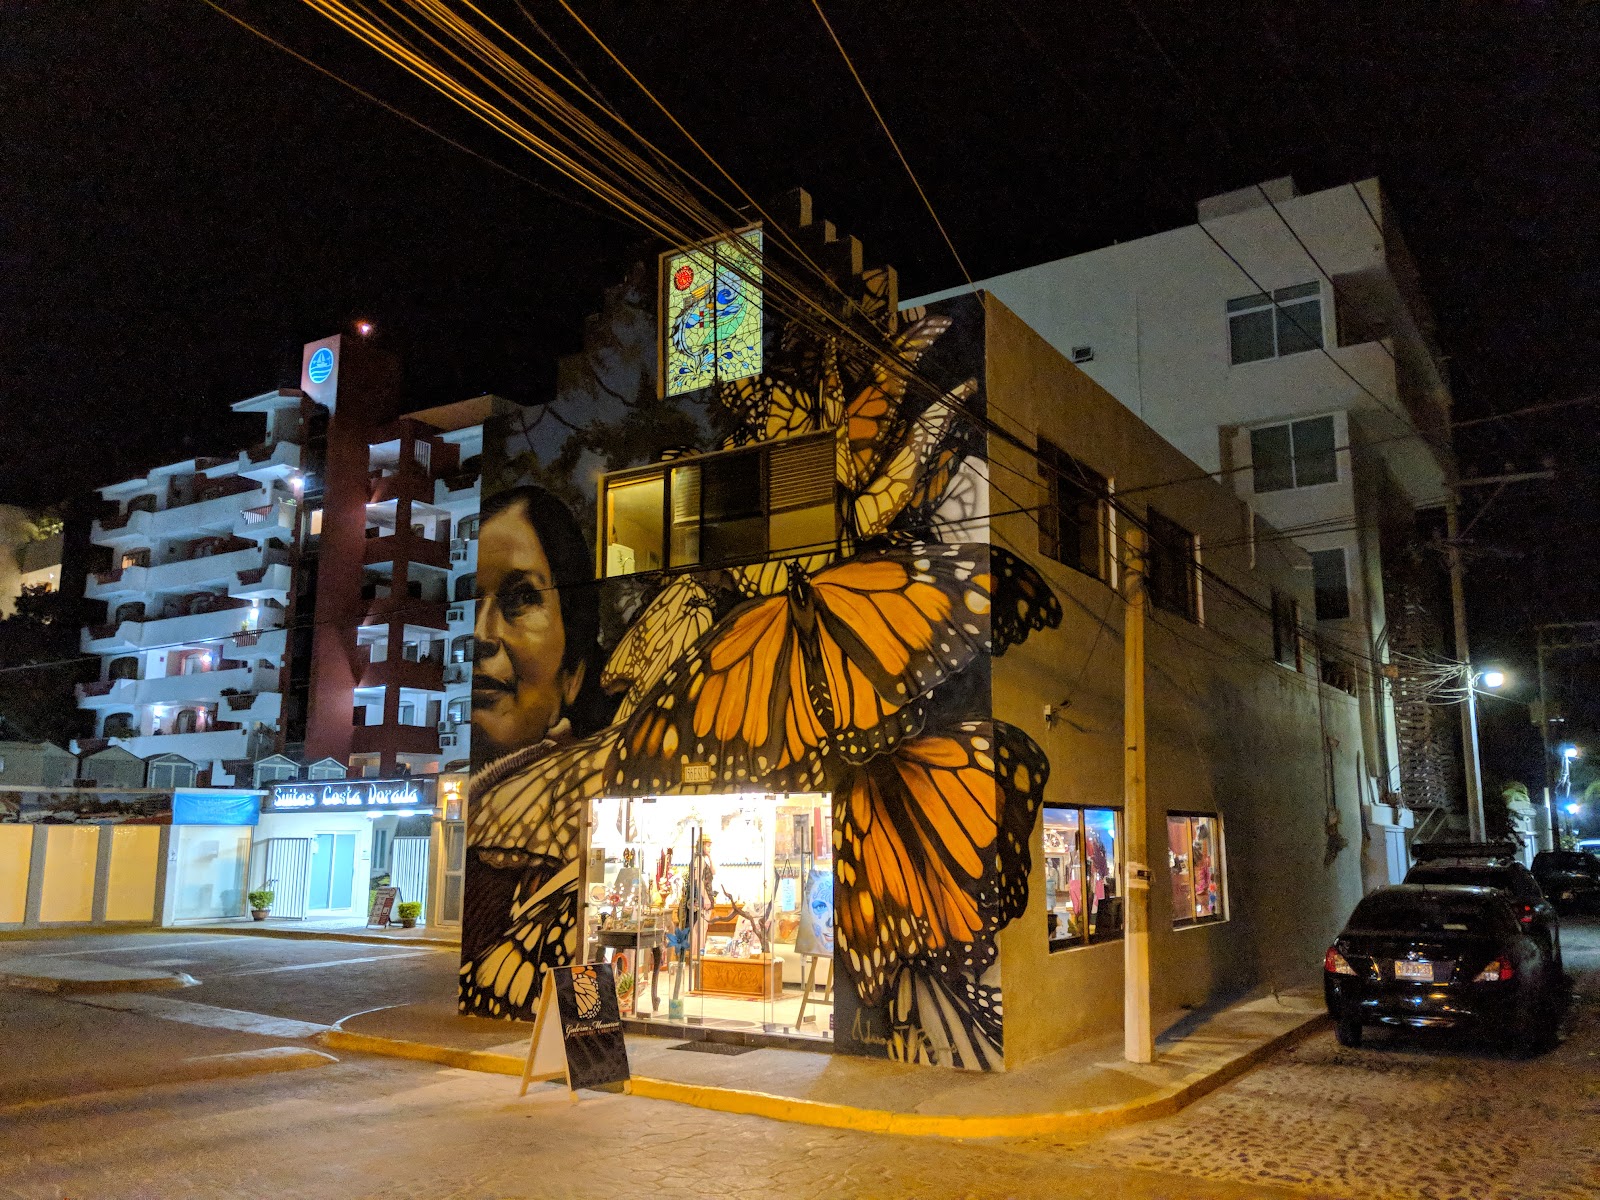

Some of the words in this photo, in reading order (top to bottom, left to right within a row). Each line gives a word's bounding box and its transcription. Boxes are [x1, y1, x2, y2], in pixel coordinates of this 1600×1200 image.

[274, 787, 316, 807] Suites
[322, 786, 362, 806] Costa
[368, 782, 418, 805] Dorada
